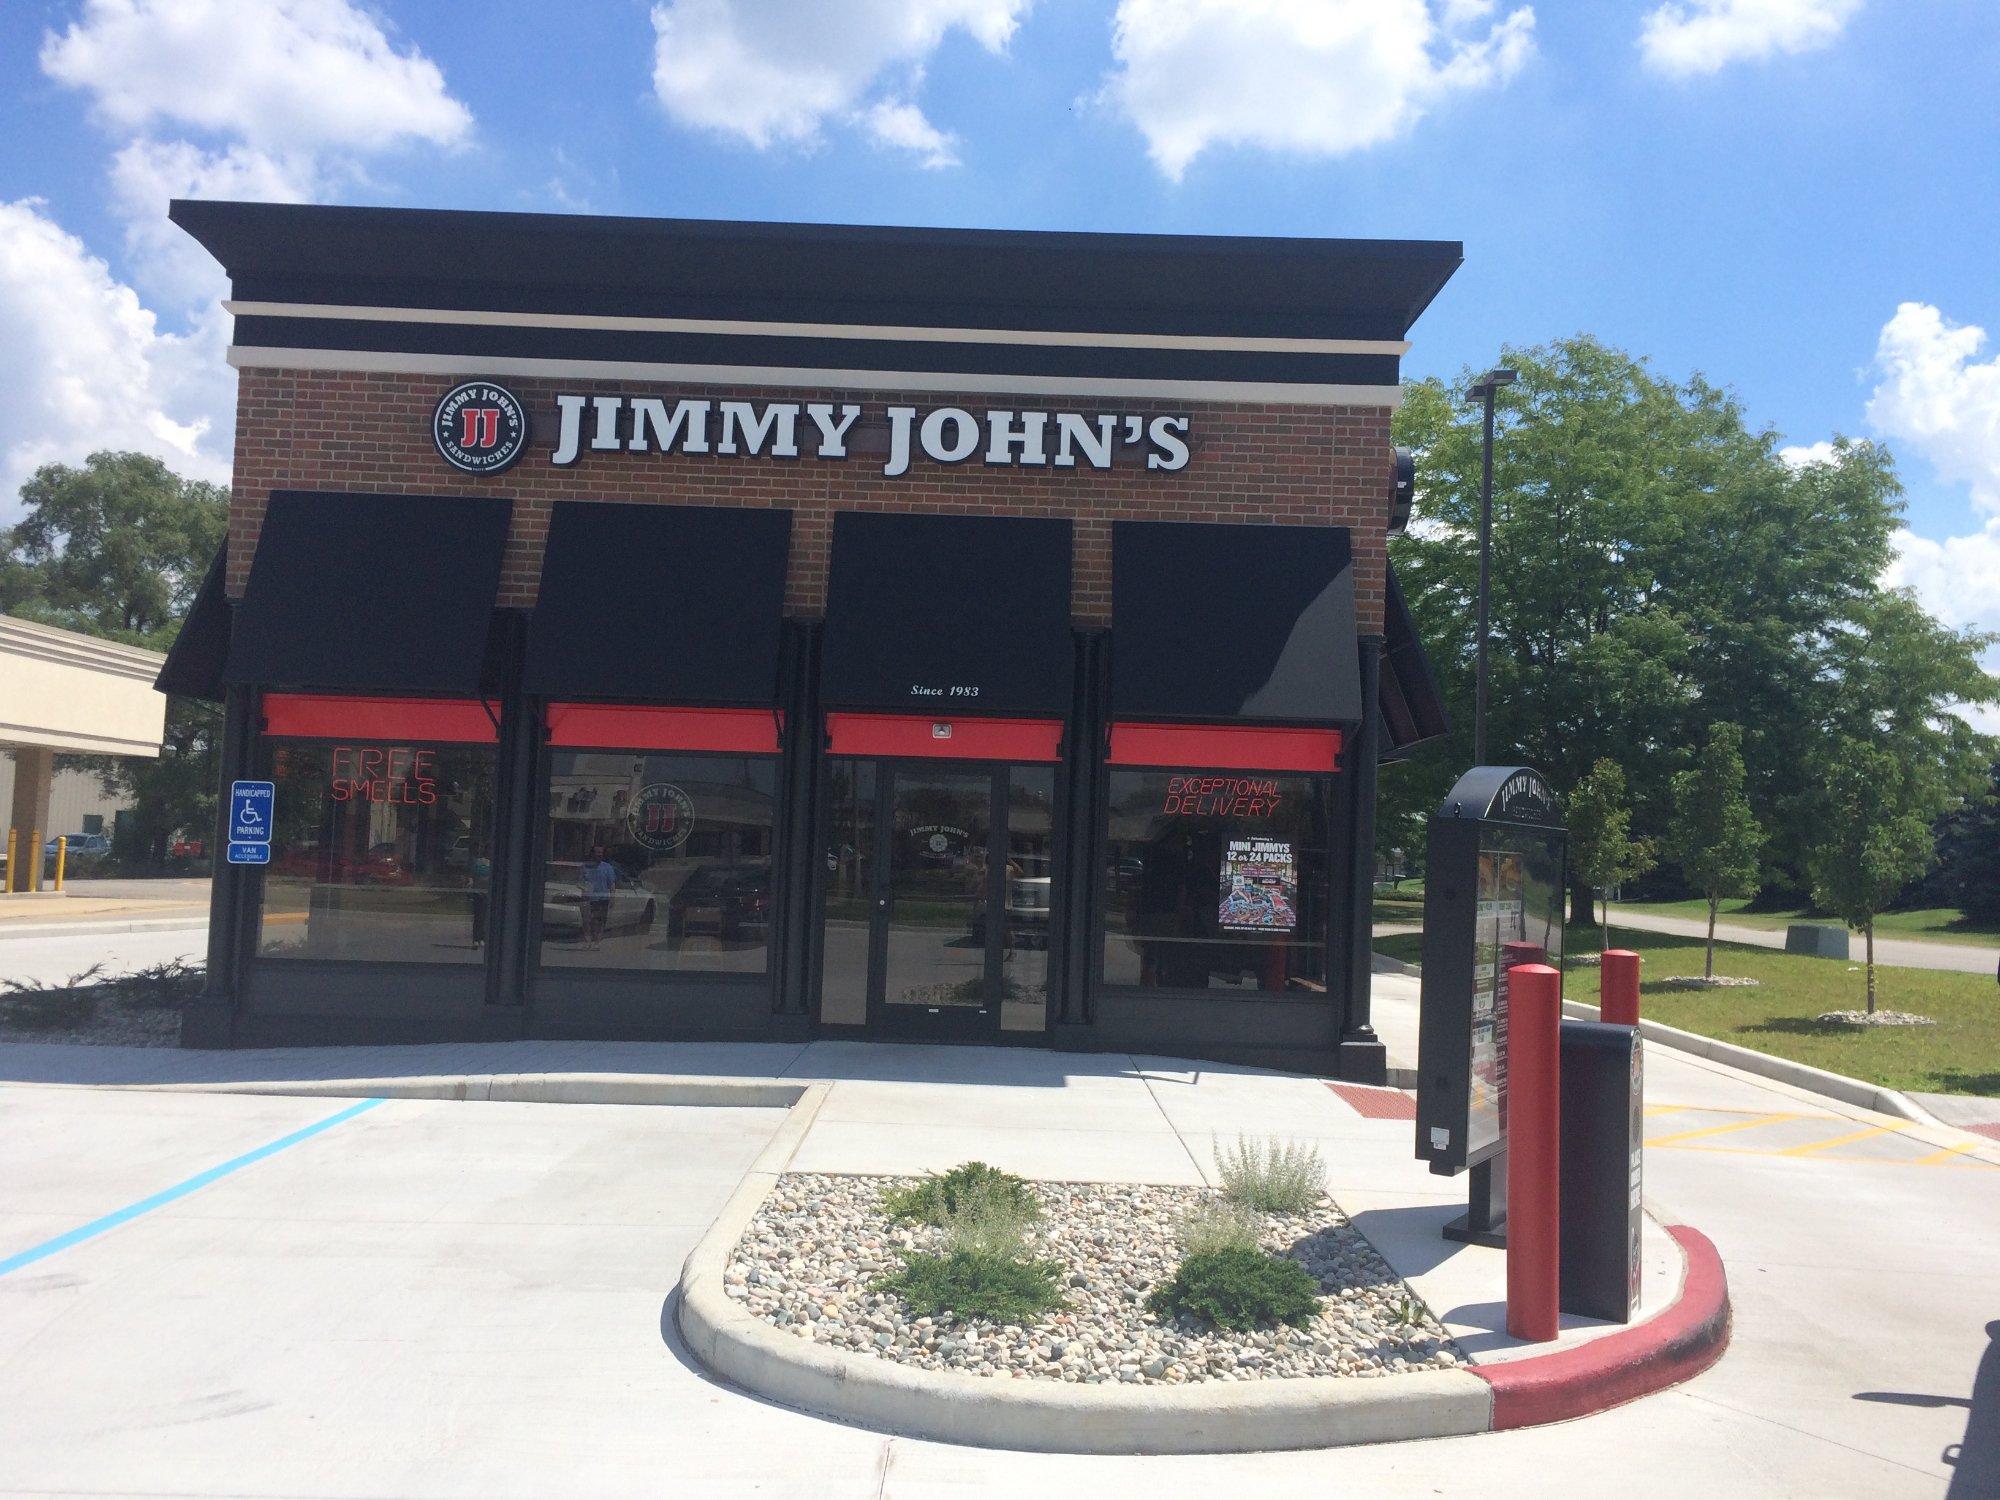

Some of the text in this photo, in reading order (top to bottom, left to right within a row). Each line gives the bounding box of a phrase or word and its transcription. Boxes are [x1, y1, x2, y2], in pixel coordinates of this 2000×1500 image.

[442, 389, 518, 428] JIMMY JOHN'S
[461, 408, 500, 448] JJ
[552, 395, 1190, 476] JIMMY JOHN'S
[446, 441, 513, 465] SANDWICHES
[910, 684, 979, 697] Since 1983
[332, 747, 437, 781] FREE
[235, 788, 271, 798] HANDICAPPED
[331, 779, 437, 804] SMELLS
[1168, 777, 1282, 798] EXCEPTIONAL
[1501, 775, 1527, 812] JIMMY
[1163, 795, 1281, 817] DELIVERY
[236, 826, 265, 835] PARKING
[909, 825, 969, 838] JIMMY JOHN'S
[1226, 851, 1237, 861] 12
[1249, 852, 1261, 862] 24
[1263, 853, 1293, 864] PACKS
[1229, 841, 1290, 853] MINI JIMMYS
